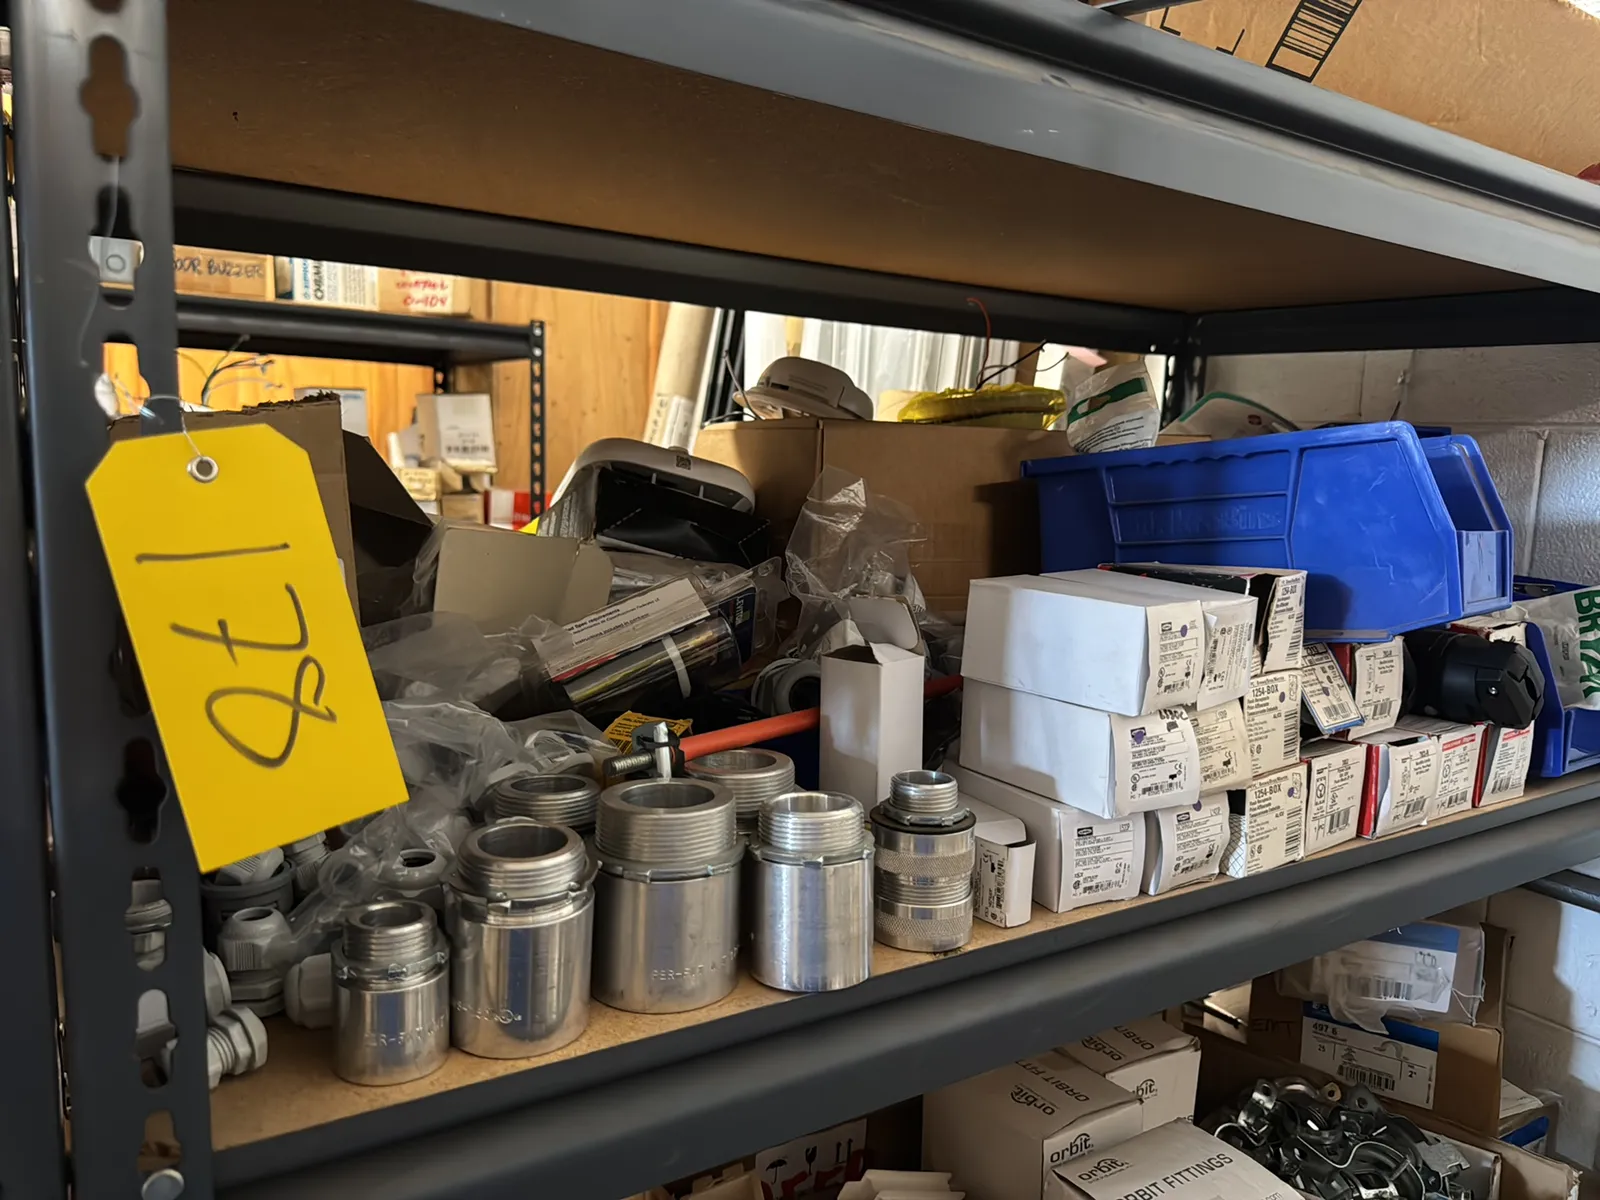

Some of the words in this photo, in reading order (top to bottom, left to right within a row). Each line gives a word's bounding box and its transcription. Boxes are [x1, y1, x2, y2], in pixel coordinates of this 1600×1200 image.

[1252, 684, 1279, 698] 1254-BOX
[1254, 784, 1282, 800] 1254-BOX
[1010, 1084, 1056, 1116] orbit
[1042, 1076, 1090, 1102] ORBIT
[1050, 1132, 1094, 1163] orbit
[1078, 1158, 1129, 1181] orbit
[1162, 1153, 1234, 1189] FITTINGS
